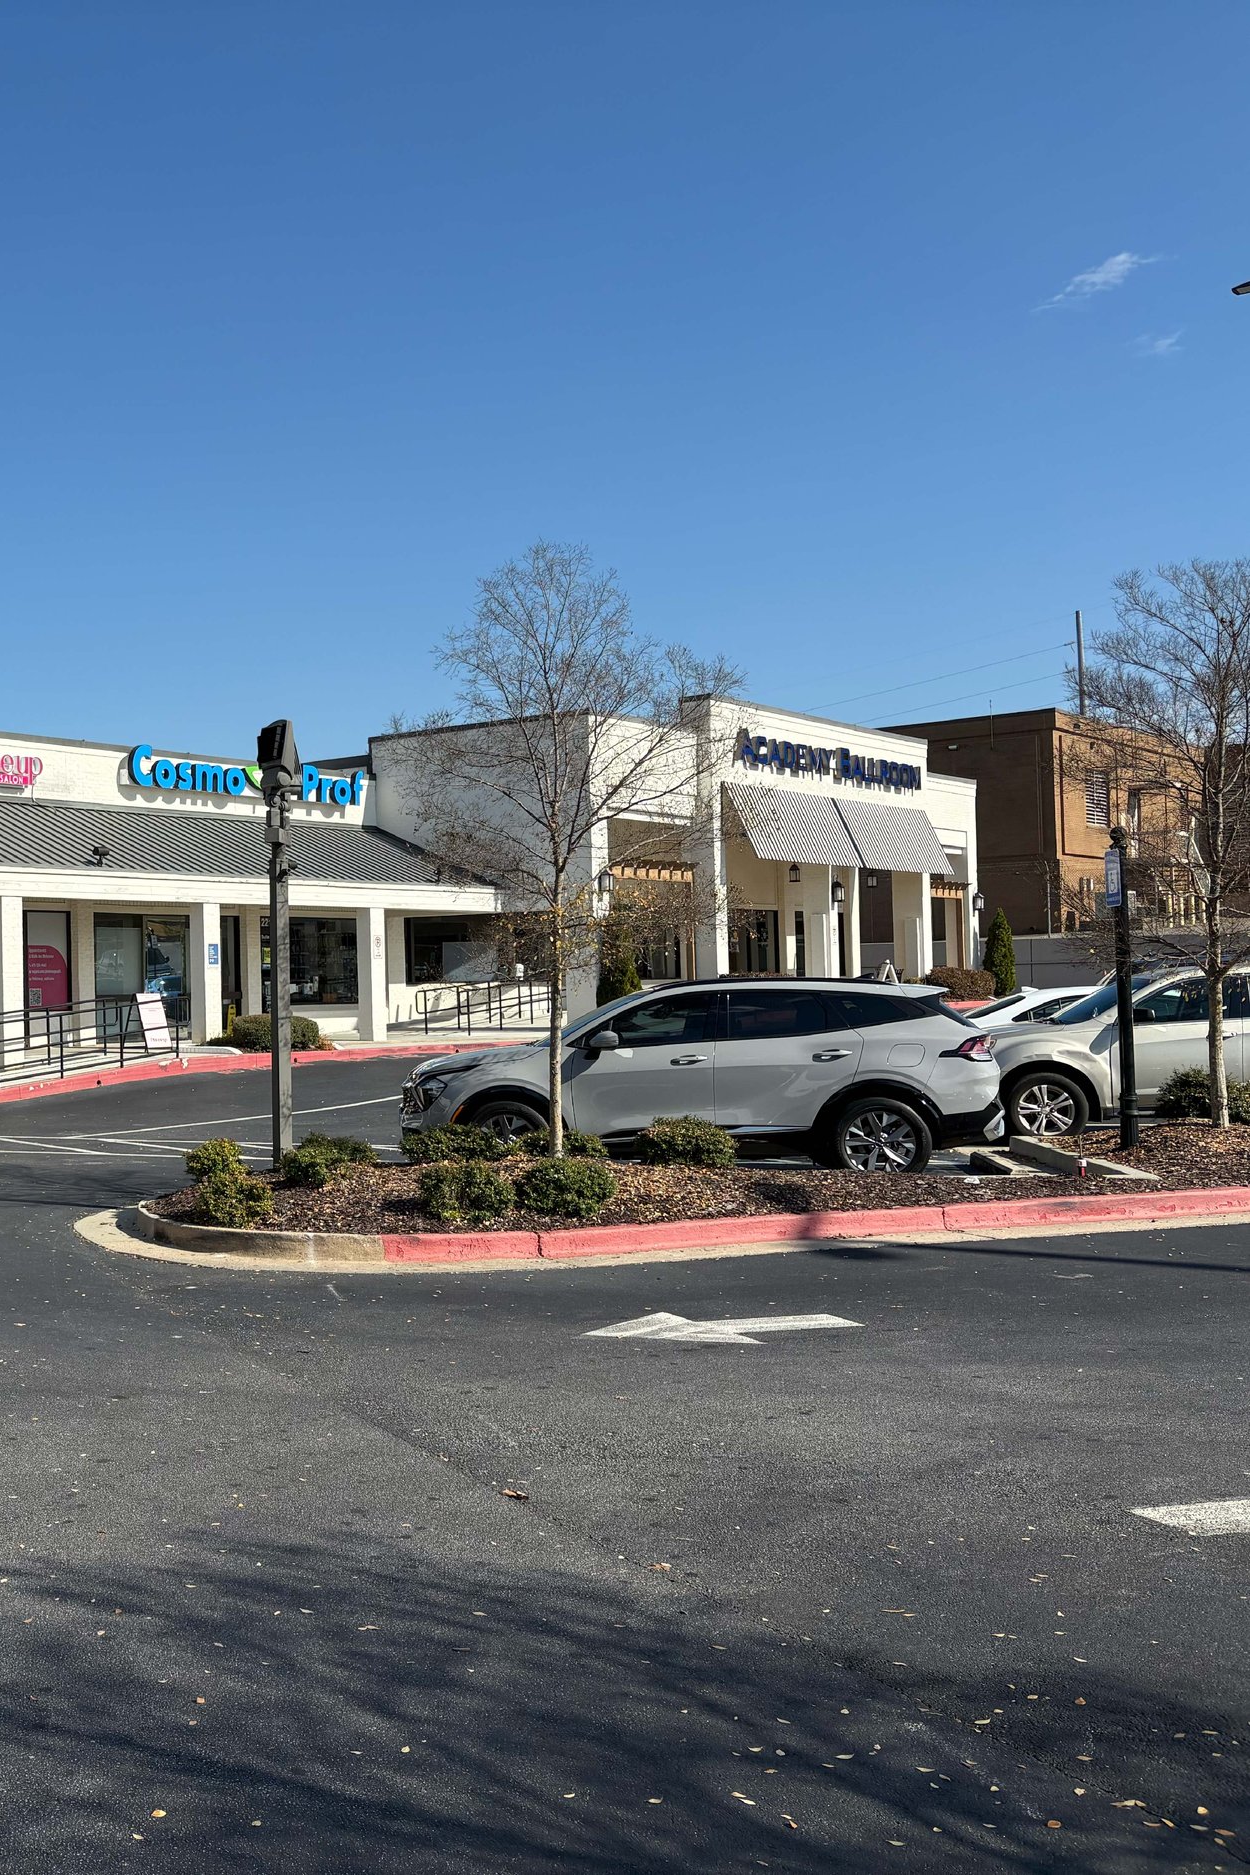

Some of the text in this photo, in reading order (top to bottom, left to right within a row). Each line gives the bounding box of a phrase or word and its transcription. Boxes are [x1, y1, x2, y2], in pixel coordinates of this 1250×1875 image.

[0, 775, 24, 785] SALON
[128, 744, 364, 806] Cosmo Prof
[735, 728, 922, 791] ACADEMY BALLROOM
